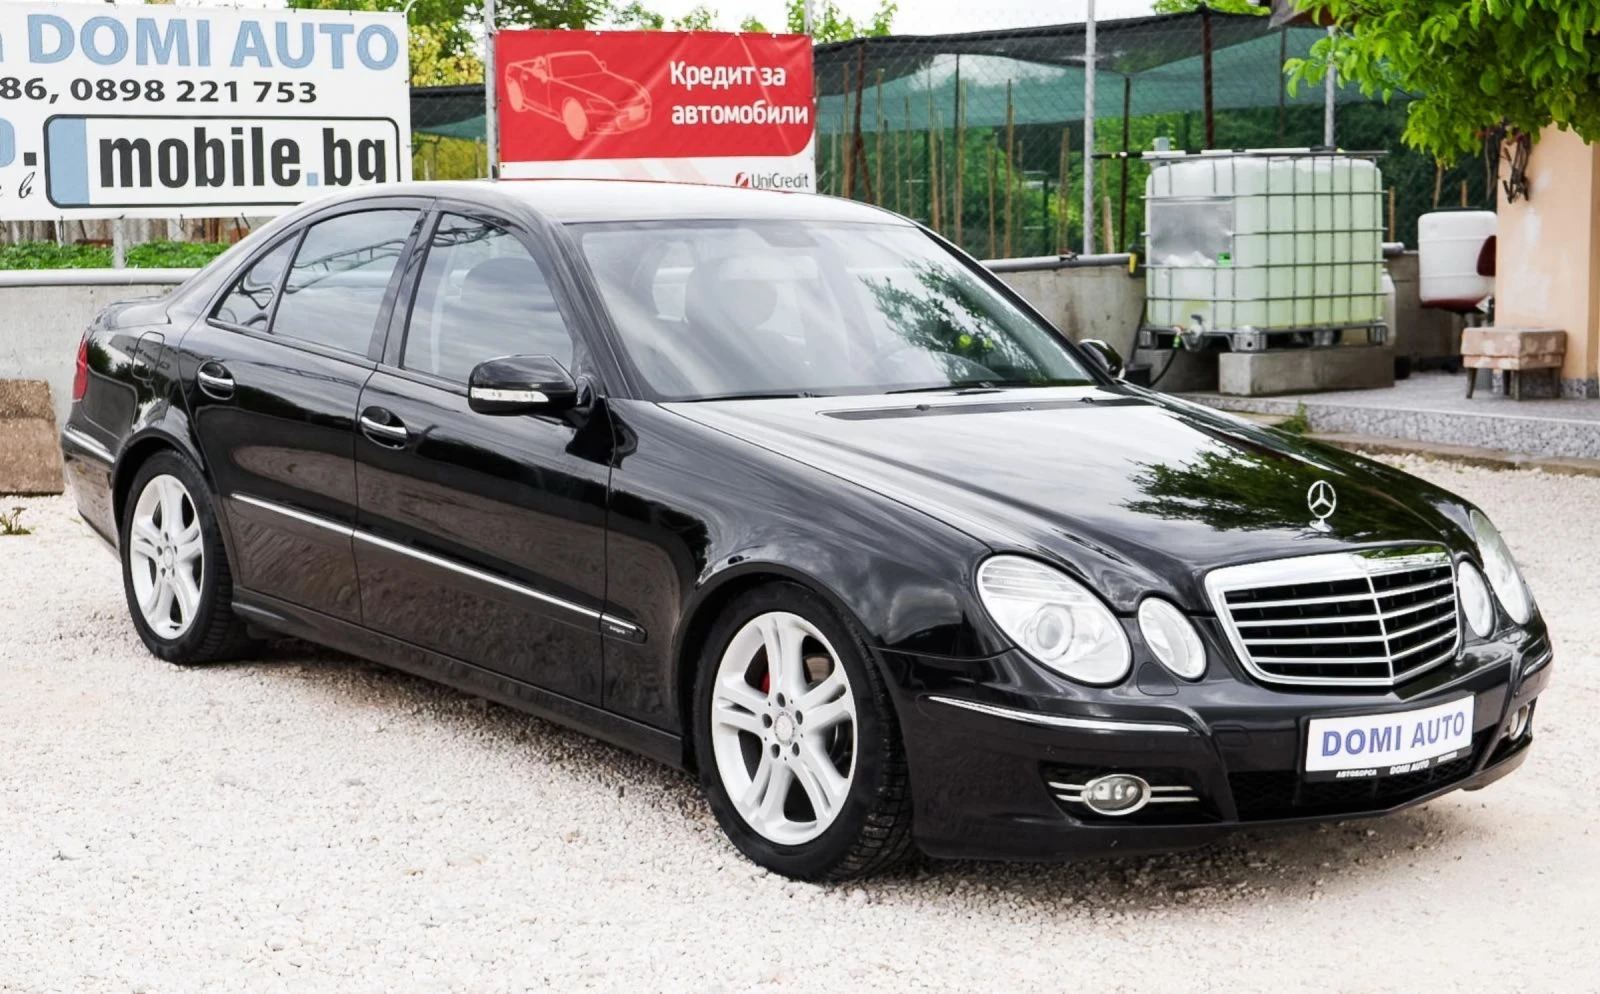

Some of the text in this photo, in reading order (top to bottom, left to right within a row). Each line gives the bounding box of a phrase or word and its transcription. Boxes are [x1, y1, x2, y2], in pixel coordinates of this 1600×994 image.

[27, 14, 399, 70] DOMI AUTO
[70, 78, 165, 102] 0898
[176, 80, 238, 102] 221
[253, 81, 317, 103] 753
[669, 61, 786, 91] Кредит за
[671, 100, 809, 125] автомобили
[99, 127, 386, 188] mobile.bg
[751, 172, 809, 189] UniCredit
[1322, 711, 1465, 757] DOMI AUTO
